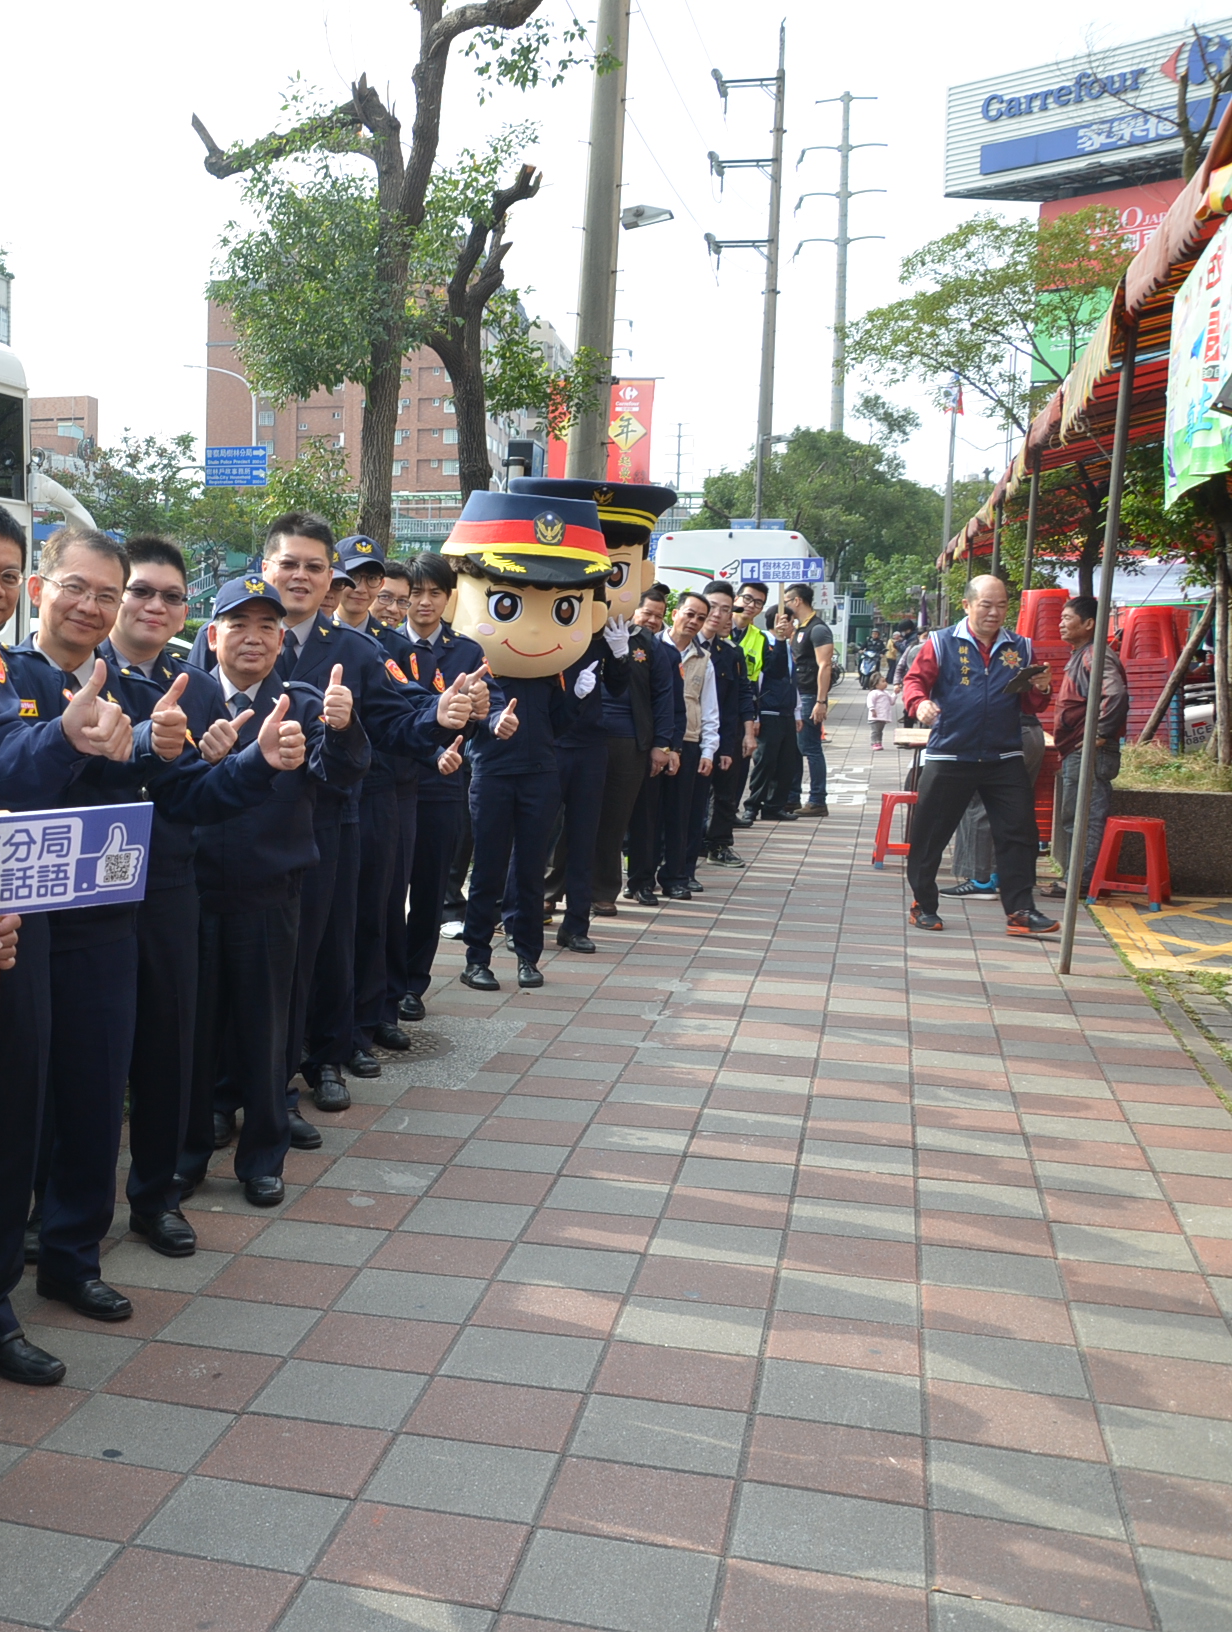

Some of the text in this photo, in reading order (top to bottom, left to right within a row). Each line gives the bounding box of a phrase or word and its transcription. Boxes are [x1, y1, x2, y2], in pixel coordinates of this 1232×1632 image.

[981, 67, 1146, 122] Carrefour
[614, 416, 637, 446] 年
[762, 561, 801, 570] 樹林分局
[762, 570, 801, 580] 警民話語
[958, 645, 970, 686] 樹林分局
[1184, 724, 1213, 738] LICE
